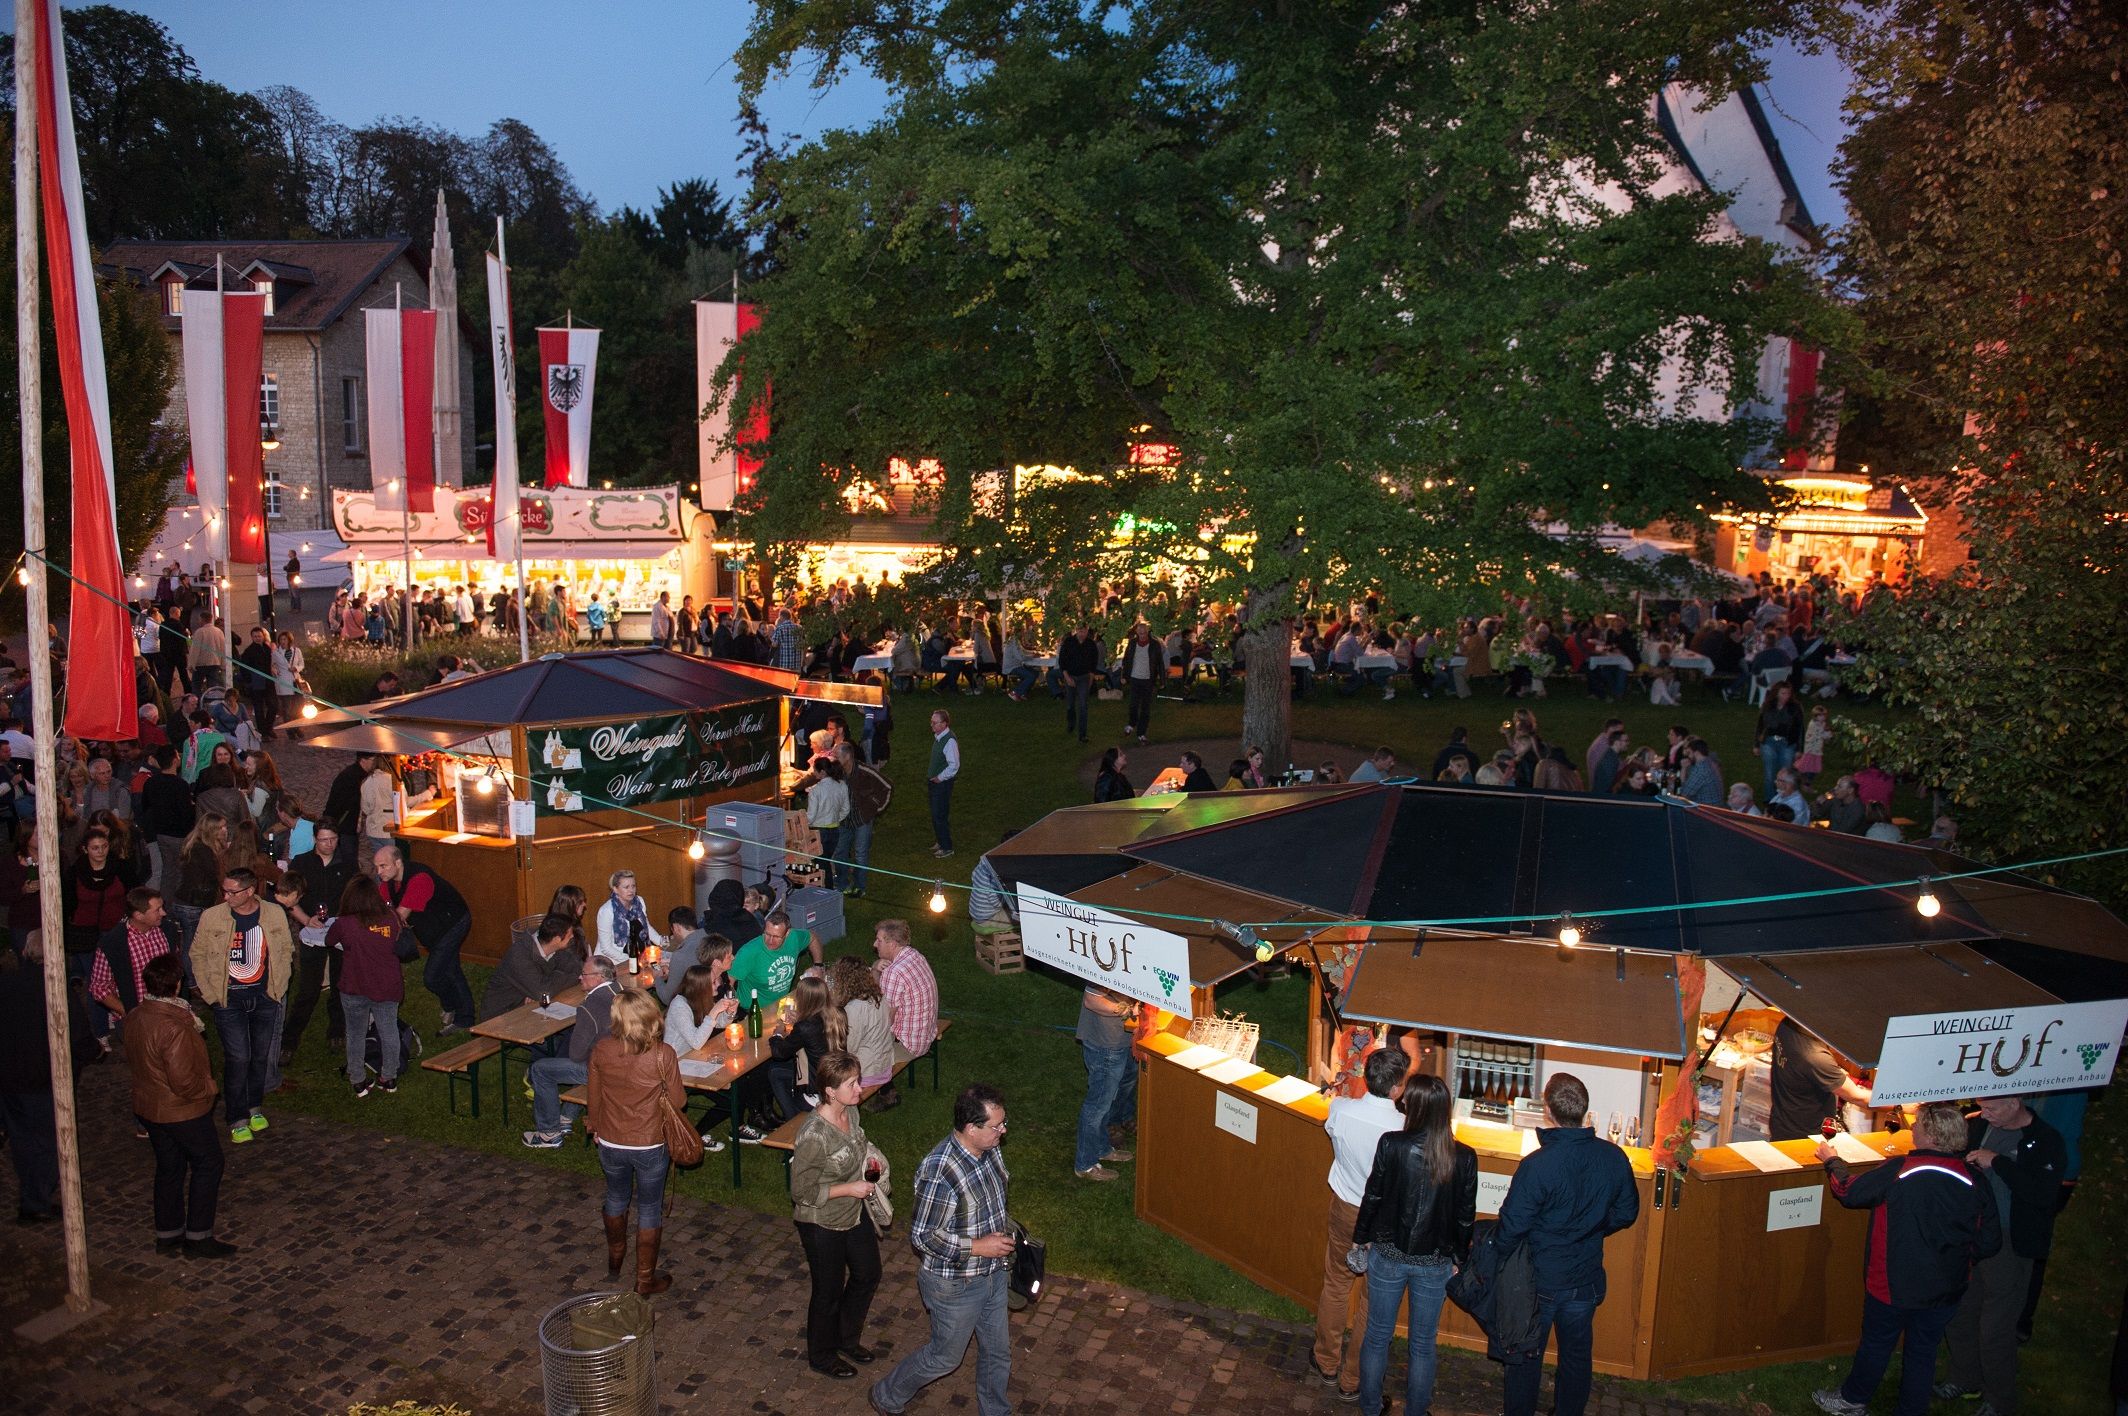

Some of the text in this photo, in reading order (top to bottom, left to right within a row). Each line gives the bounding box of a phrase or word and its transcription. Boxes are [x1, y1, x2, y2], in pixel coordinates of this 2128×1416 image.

[590, 721, 688, 762] Weingut
[700, 721, 733, 744] Werner
[607, 774, 655, 800] Wein
[672, 771, 697, 790] mit
[699, 760, 732, 785] Liebe
[727, 750, 770, 787] gemacht
[1044, 896, 1099, 927] WEINGUT
[1027, 945, 1187, 1013] Ausgezeichnete Weine aus ökologischem Anbau
[1933, 1015, 2015, 1035] WEINGUT
[1878, 1072, 2106, 1100] Ausgezeichnete Weine aus ökologischem Anbau
[1224, 1102, 1250, 1119] Glaspfand
[1779, 1195, 1813, 1206] Glaspfand
